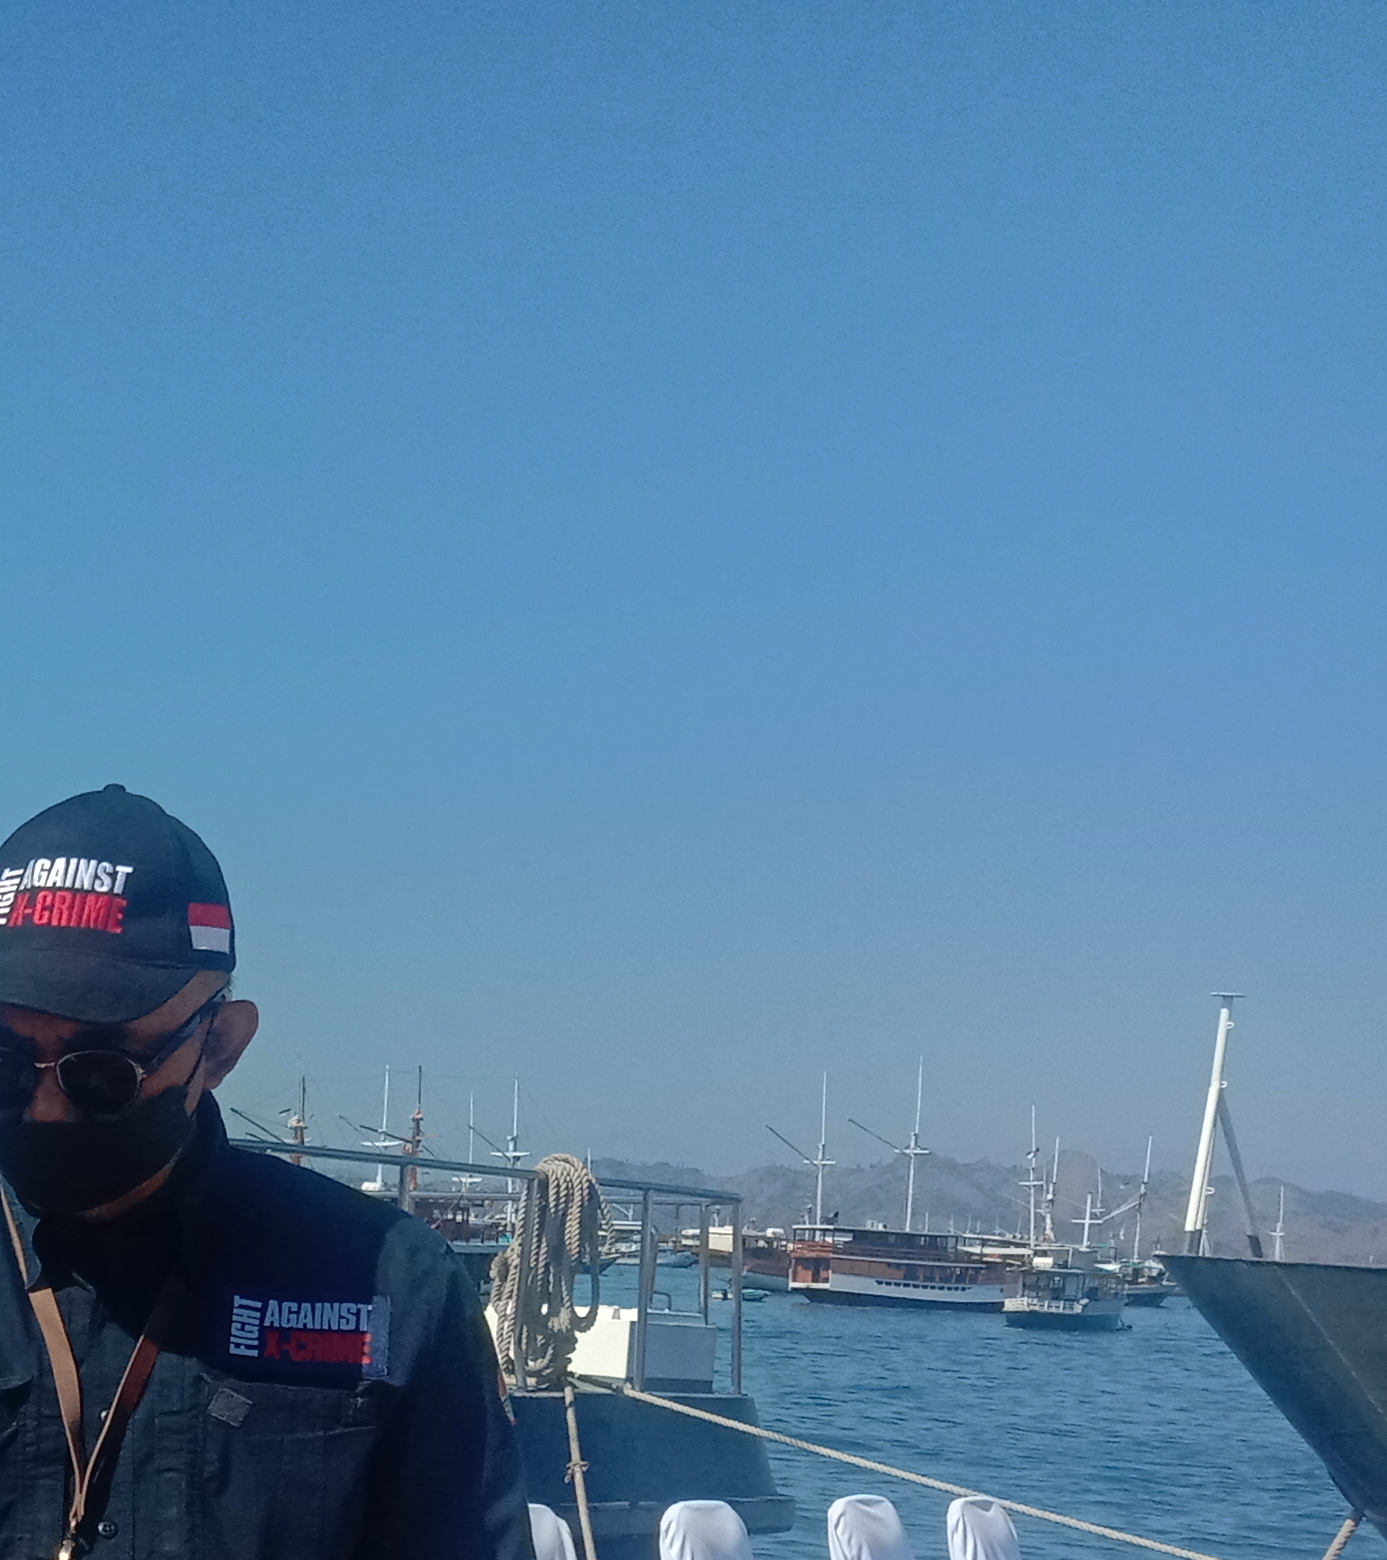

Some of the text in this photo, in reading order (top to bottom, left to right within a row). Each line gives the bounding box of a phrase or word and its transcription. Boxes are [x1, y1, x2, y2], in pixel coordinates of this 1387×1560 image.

[18, 857, 134, 894] AGAINST
[6, 890, 127, 934] X-CRIME
[229, 1295, 262, 1358] FIGHT
[263, 1300, 373, 1332] AGAINST
